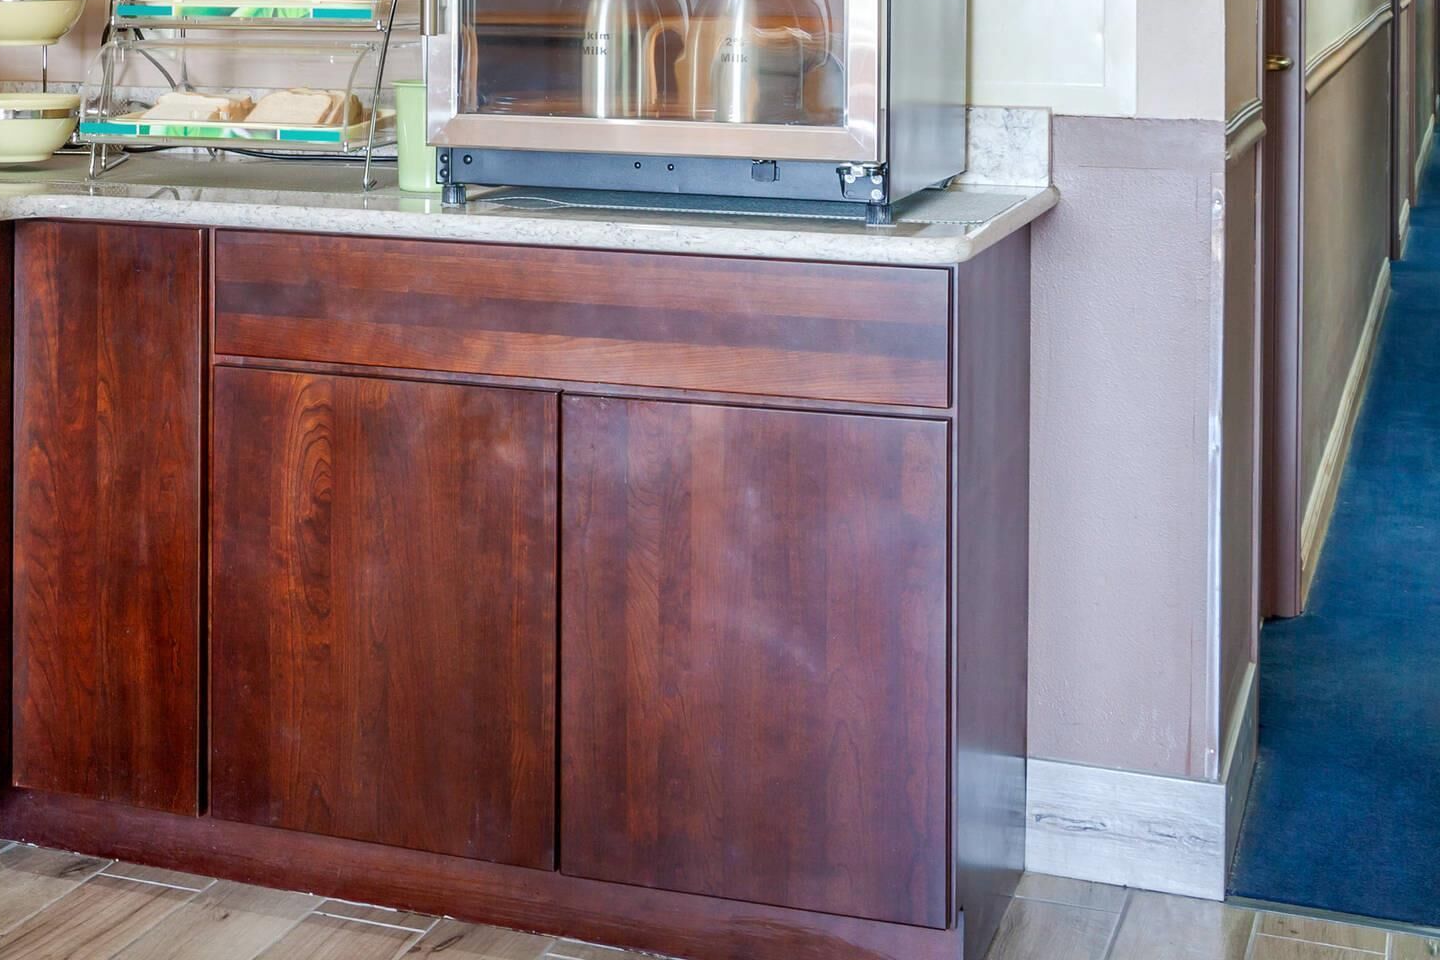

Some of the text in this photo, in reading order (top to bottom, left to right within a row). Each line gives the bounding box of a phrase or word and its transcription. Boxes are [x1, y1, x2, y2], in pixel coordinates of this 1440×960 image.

[583, 31, 610, 41] kim
[583, 46, 608, 56] Milk
[721, 53, 748, 63] Milk
